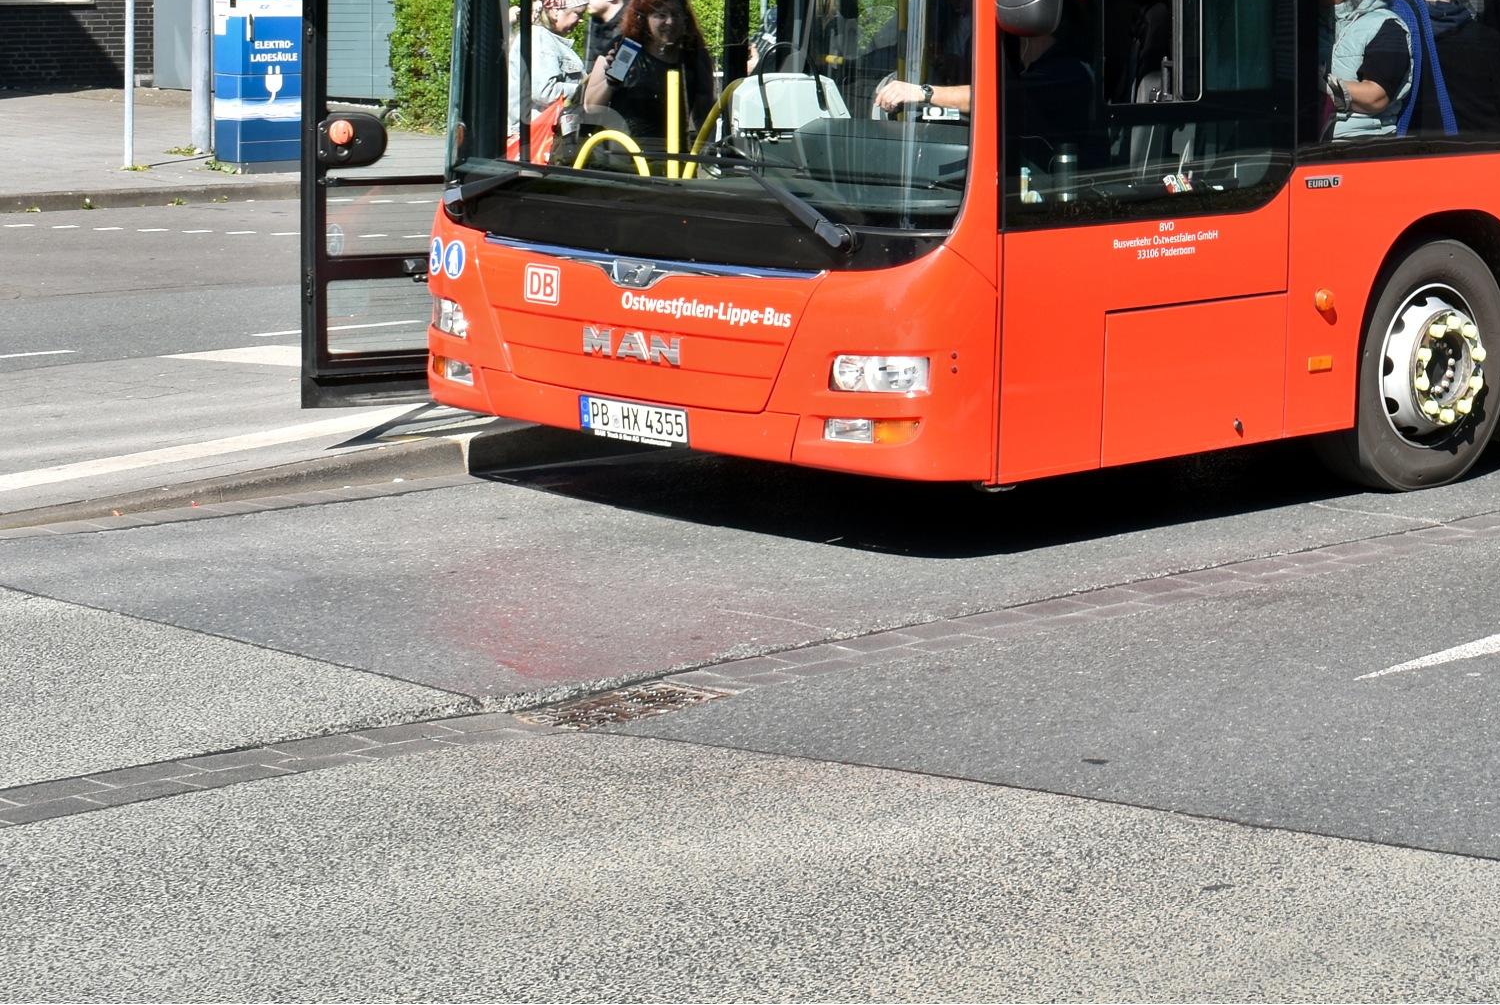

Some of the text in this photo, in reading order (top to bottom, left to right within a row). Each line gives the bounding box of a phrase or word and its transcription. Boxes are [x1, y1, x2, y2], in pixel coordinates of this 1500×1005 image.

[254, 39, 294, 49] ELEKTRO-
[250, 52, 298, 63] LADESÄULE
[1307, 177, 1340, 188] EURO 6
[1159, 221, 1174, 232] BVO
[1113, 230, 1219, 249] Busverkehr Ostwestfalen GmbH
[1137, 246, 1196, 260] 33106 Paderborn
[530, 271, 555, 296] DB
[621, 291, 791, 328] Ostwestfalen-Lippe-Bus
[583, 325, 682, 367] MAN
[591, 401, 684, 437] PB HX 4355
